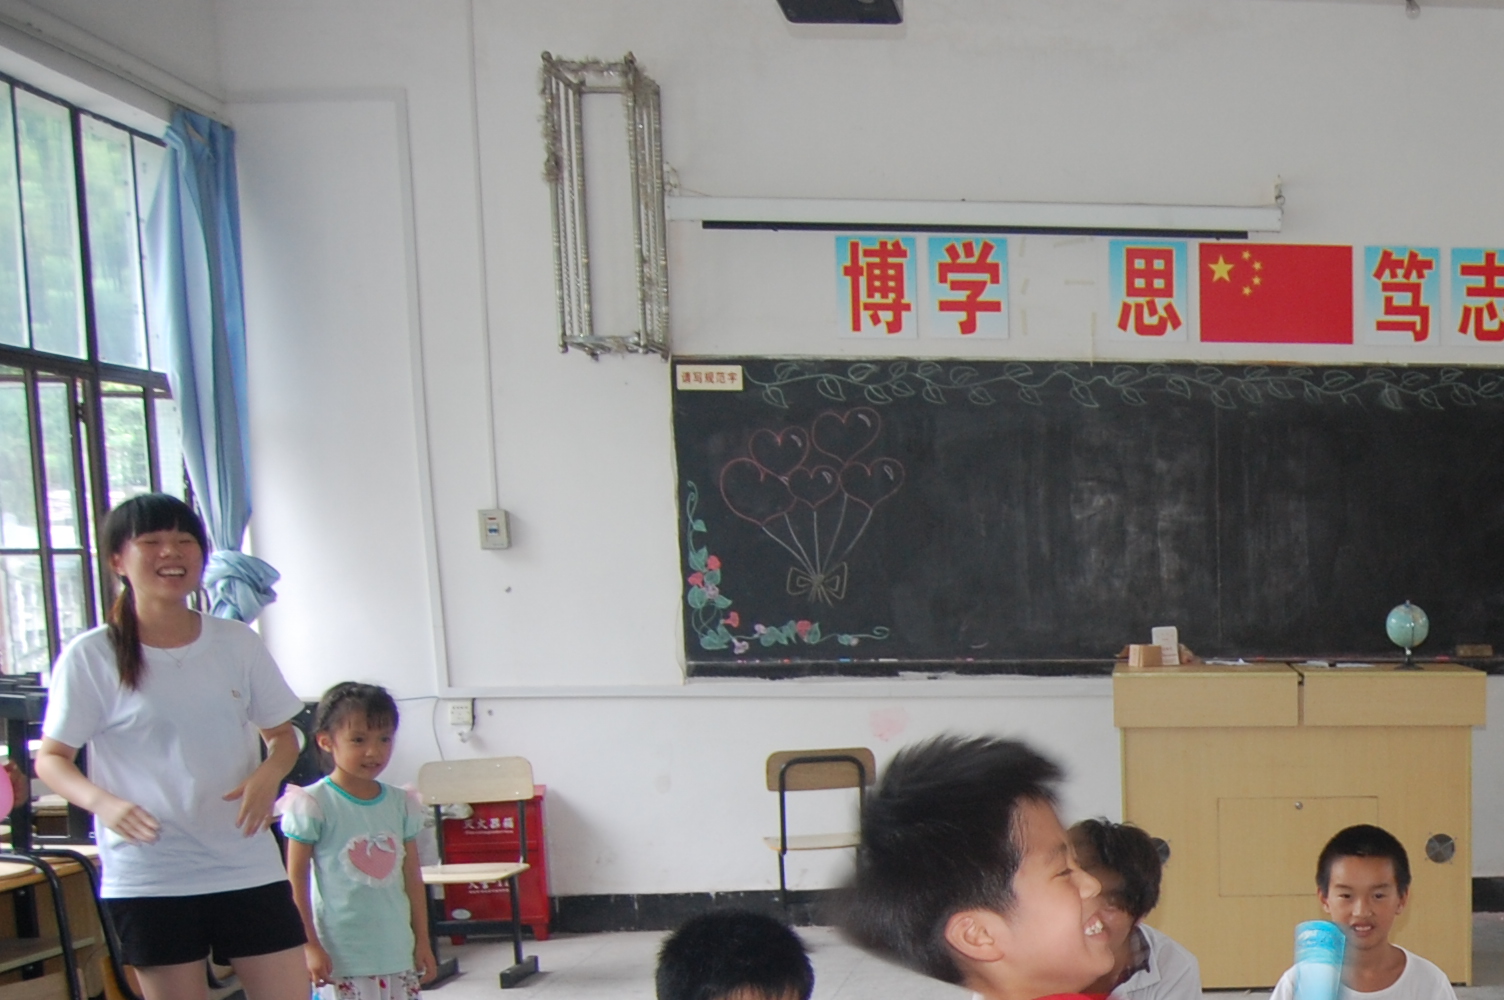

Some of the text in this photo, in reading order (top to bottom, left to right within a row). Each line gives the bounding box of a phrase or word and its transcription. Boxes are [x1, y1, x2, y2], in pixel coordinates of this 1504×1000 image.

[842, 239, 1002, 336] 博学
[1116, 246, 1183, 338] 思
[682, 371, 738, 384] 请写规范字
[463, 817, 515, 830] 灭火器箱
